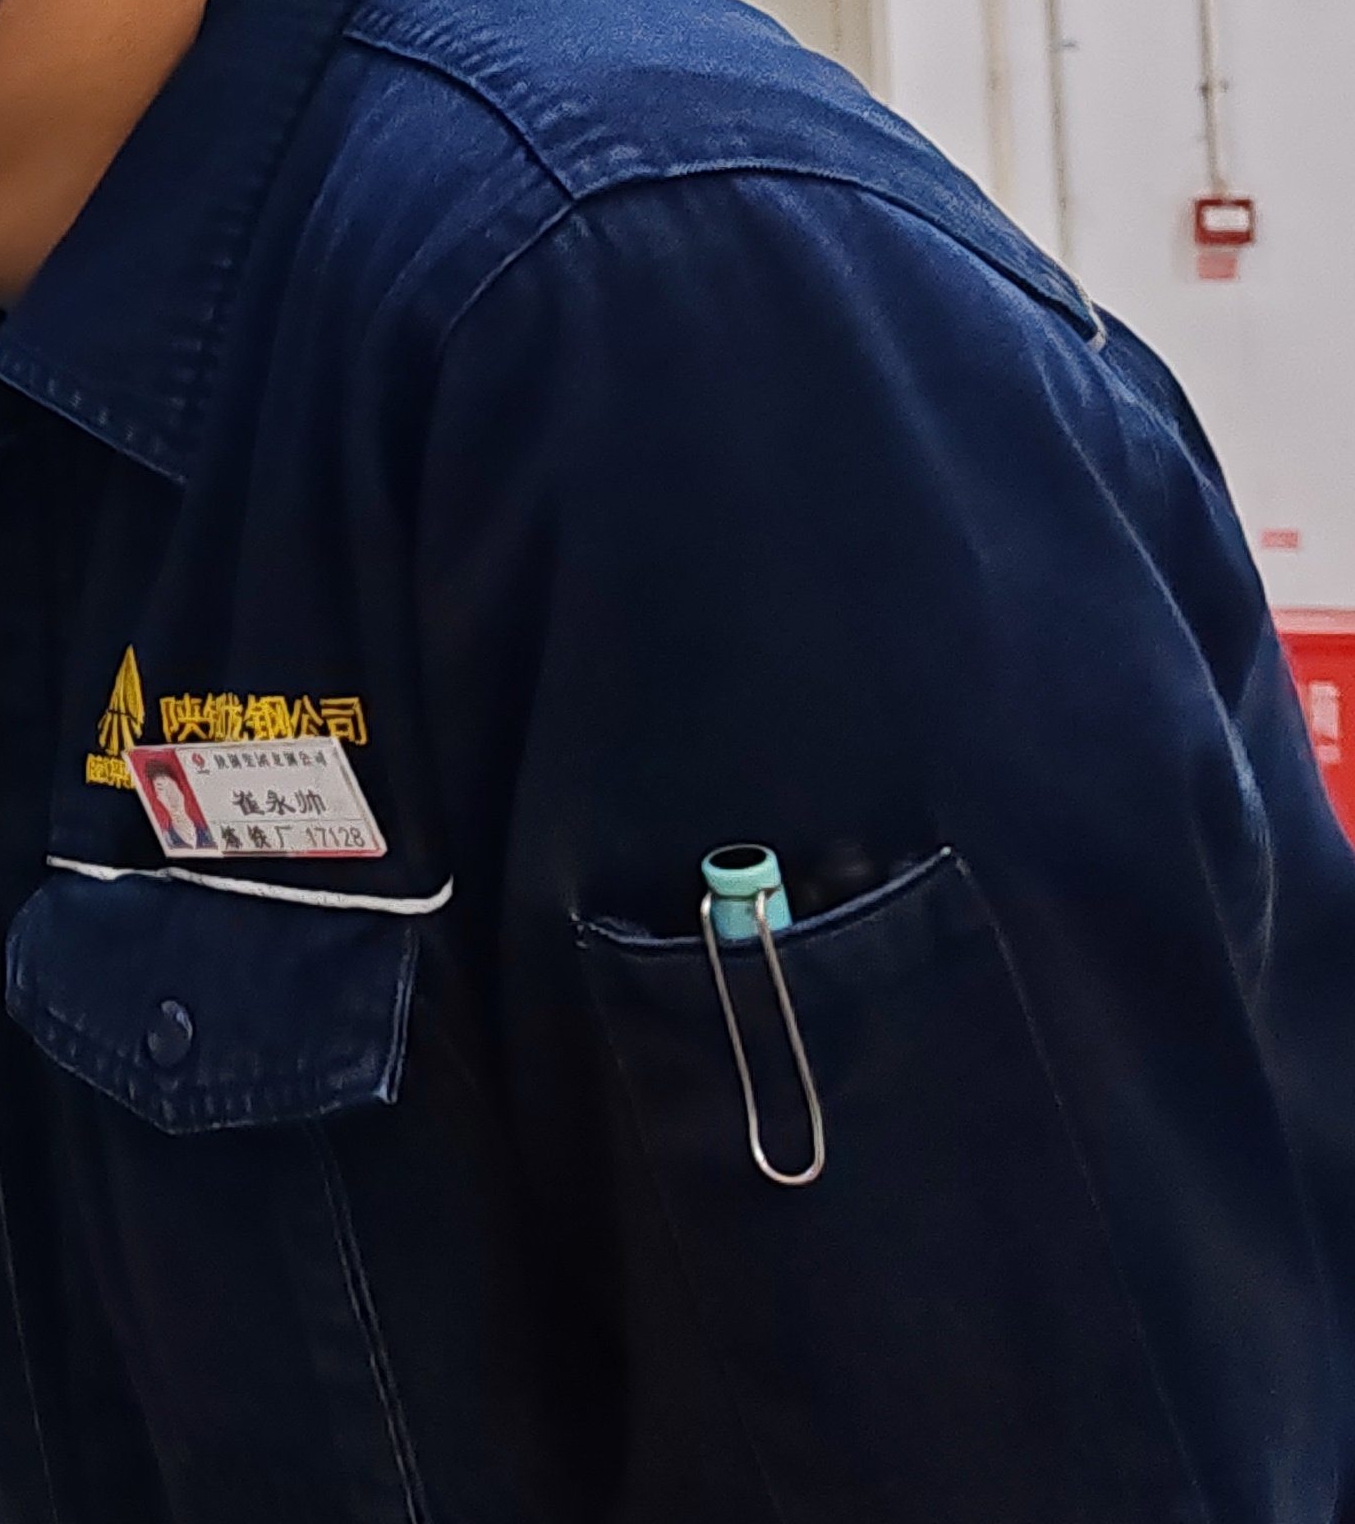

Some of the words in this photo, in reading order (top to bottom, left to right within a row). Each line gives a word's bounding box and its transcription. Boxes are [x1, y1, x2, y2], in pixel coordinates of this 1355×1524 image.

[232, 789, 327, 816] 崔永帅
[305, 826, 366, 848] 17128
